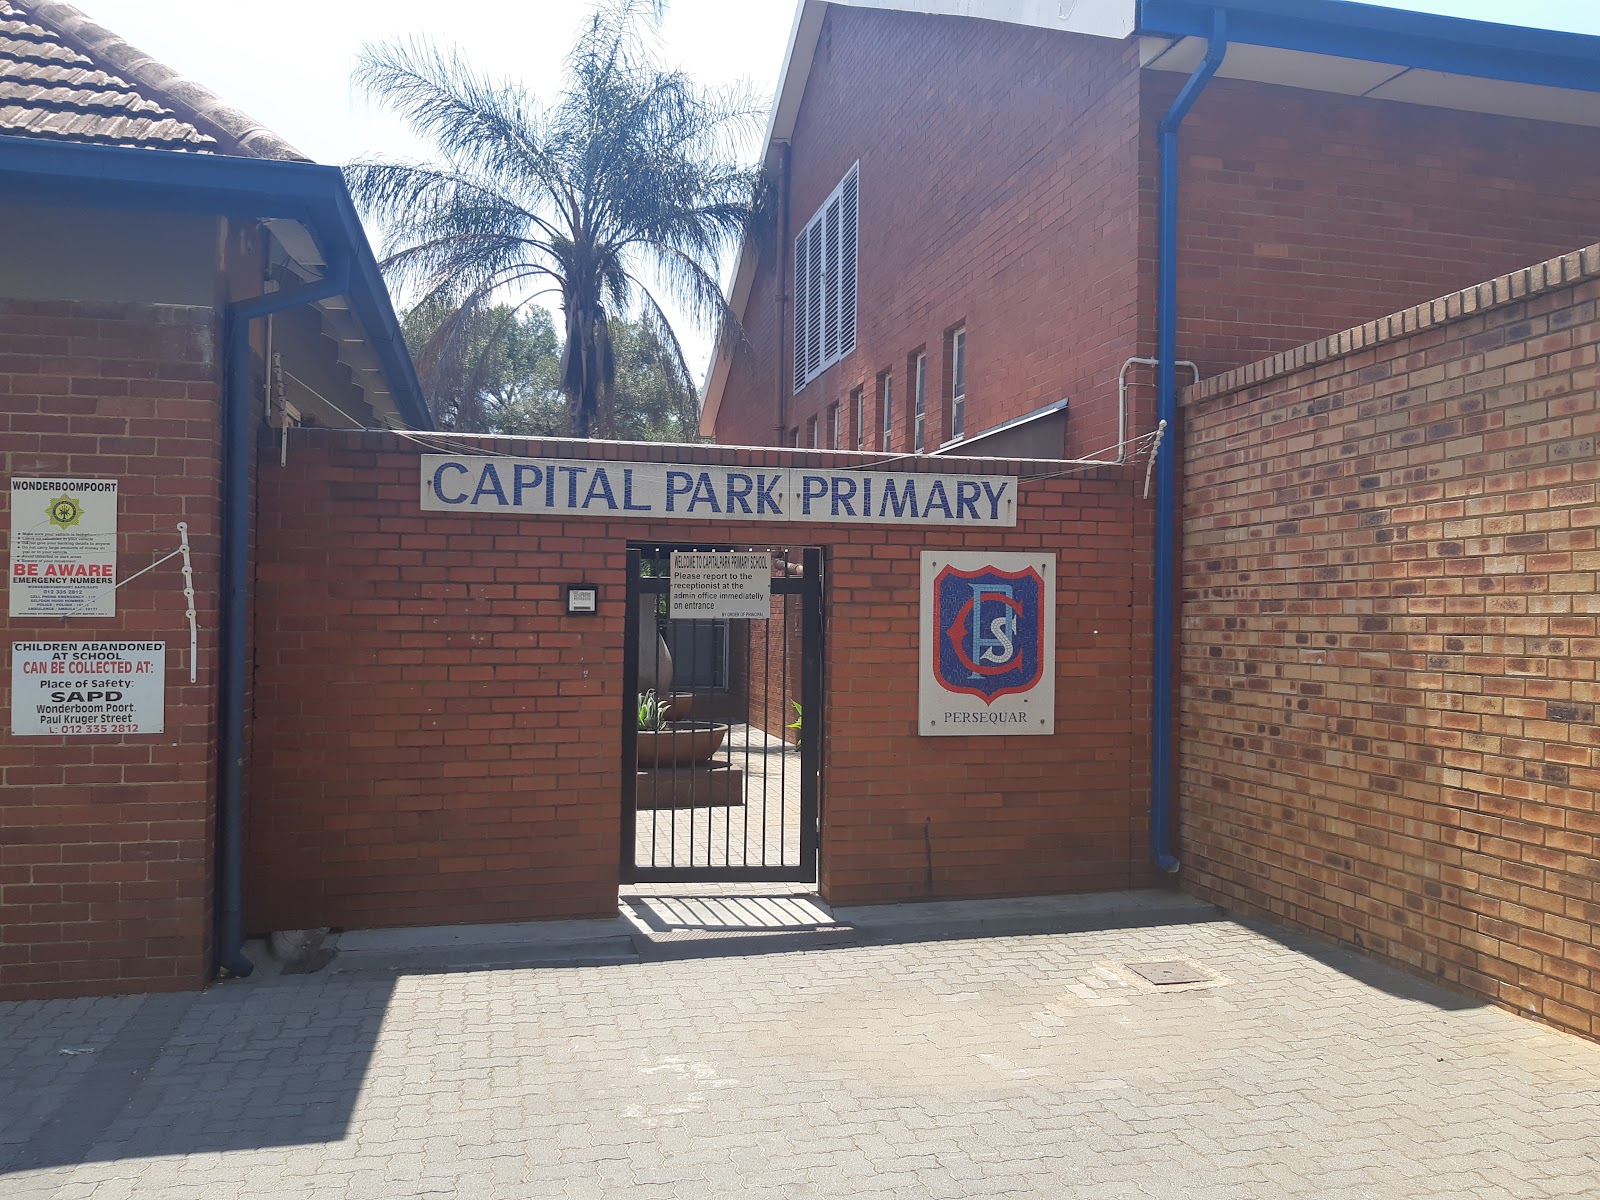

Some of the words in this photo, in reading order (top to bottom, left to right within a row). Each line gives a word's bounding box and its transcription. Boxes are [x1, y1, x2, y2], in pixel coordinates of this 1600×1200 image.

[12, 481, 117, 492] WONDERBOOMPOORT
[433, 462, 652, 511] CAPITAL
[665, 471, 783, 515] PARK
[802, 475, 1008, 520] PRIMARY
[750, 555, 768, 570] SCHOOL
[14, 563, 38, 576] BE
[44, 563, 113, 576] AWARE
[674, 572, 701, 580] Please
[703, 573, 728, 581] report
[740, 572, 753, 580] the
[673, 582, 720, 591] receptionist
[731, 582, 744, 590] the
[697, 592, 718, 600] office
[720, 592, 764, 602] immediatelly
[673, 602, 683, 610] on
[684, 601, 715, 610] entrance
[14, 643, 78, 652] CHILDREN
[81, 643, 162, 651] ABANDONED
[52, 652, 69, 660] AT
[72, 652, 126, 660] SCHOOL.
[23, 661, 48, 674] CAN
[50, 661, 65, 674] BE
[68, 661, 133, 674] COLLECTED
[135, 661, 154, 674] AT:
[40, 680, 72, 689] Place
[75, 679, 88, 689] of
[91, 679, 135, 689] Safety:
[51, 691, 123, 703] SAPD
[36, 704, 103, 714] Wonderboom
[106, 703, 137, 713] Poort.
[40, 715, 62, 724] Paul
[64, 714, 99, 725] Kruger
[101, 713, 133, 723] Street
[944, 711, 1028, 725] PERSEQUAR
[61, 725, 82, 734] 012
[86, 725, 108, 733] 335
[111, 724, 139, 733] 2812
